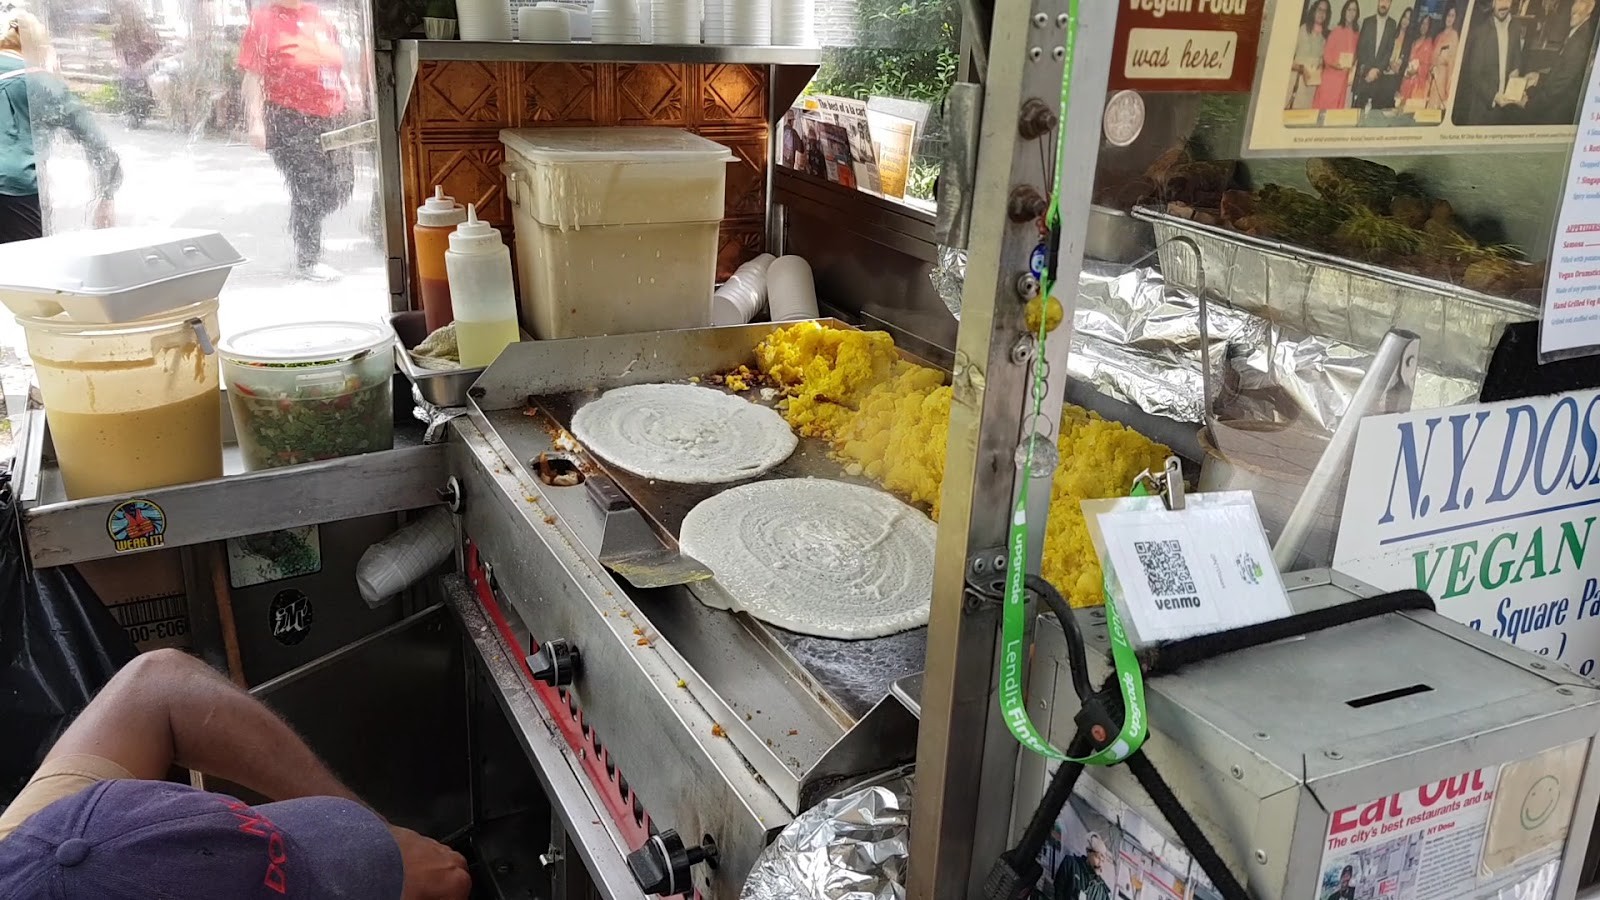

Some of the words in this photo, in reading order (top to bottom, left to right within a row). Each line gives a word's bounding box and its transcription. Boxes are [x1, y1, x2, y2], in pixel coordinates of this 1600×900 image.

[1132, 46, 1170, 68] was
[1179, 39, 1231, 69] here!
[818, 98, 828, 109] The
[827, 100, 839, 112] best
[1558, 271, 1574, 280] Vegan
[1553, 301, 1567, 310] Hand
[1568, 299, 1585, 308] Grilled
[1586, 298, 1596, 307] Veg
[1378, 411, 1490, 525] N.Y.
[1485, 394, 1600, 504] DOS
[116, 537, 149, 551] WEAR
[149, 534, 164, 547] IT!
[1412, 516, 1597, 599] VEGAN
[1011, 533, 1024, 605] upgrade
[1155, 596, 1201, 610] venmo
[1492, 597, 1569, 644] Square
[1122, 671, 1141, 738] upgrade
[1328, 836, 1348, 850] The
[1351, 825, 1377, 845] city's
[1380, 819, 1403, 835] best
[1406, 801, 1461, 827] restaurants
[1463, 793, 1481, 808] and
[1427, 826, 1438, 835] NY
[1438, 821, 1456, 834] Dosa
